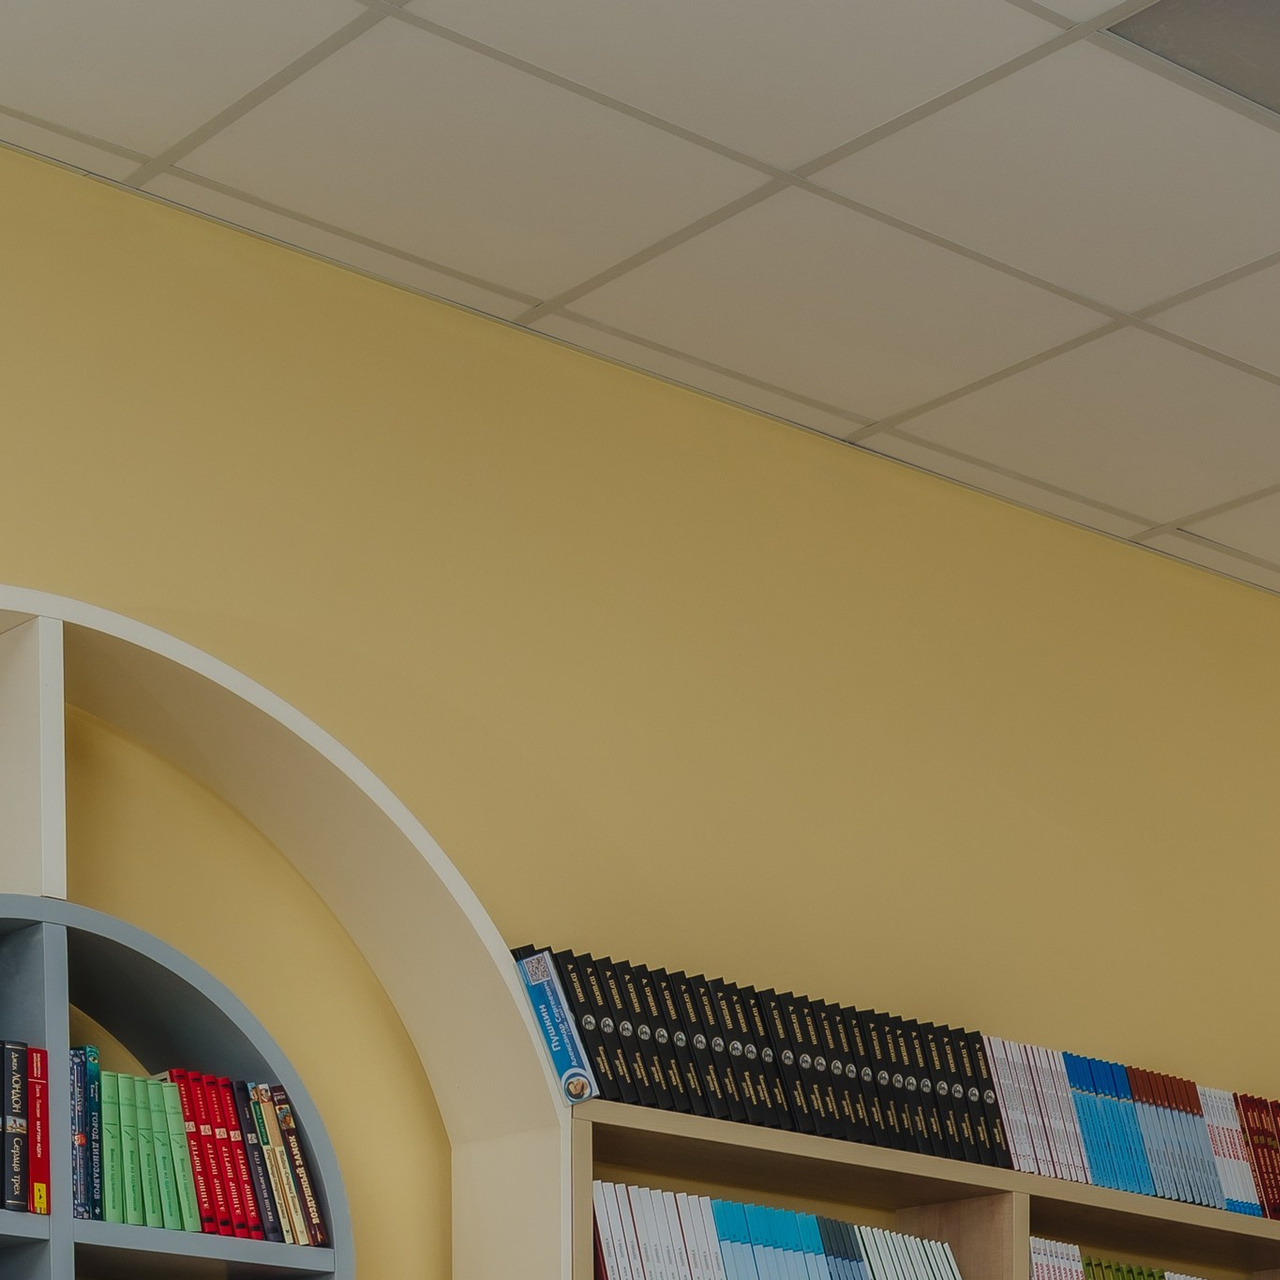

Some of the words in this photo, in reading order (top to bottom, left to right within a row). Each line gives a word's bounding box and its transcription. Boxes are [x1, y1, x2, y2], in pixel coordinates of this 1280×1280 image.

[539, 1004, 560, 1051] Пушкин
[92, 1144, 100, 1200] ДИНОЗАВРОВ
[288, 1135, 303, 1169] ЗАМОК
